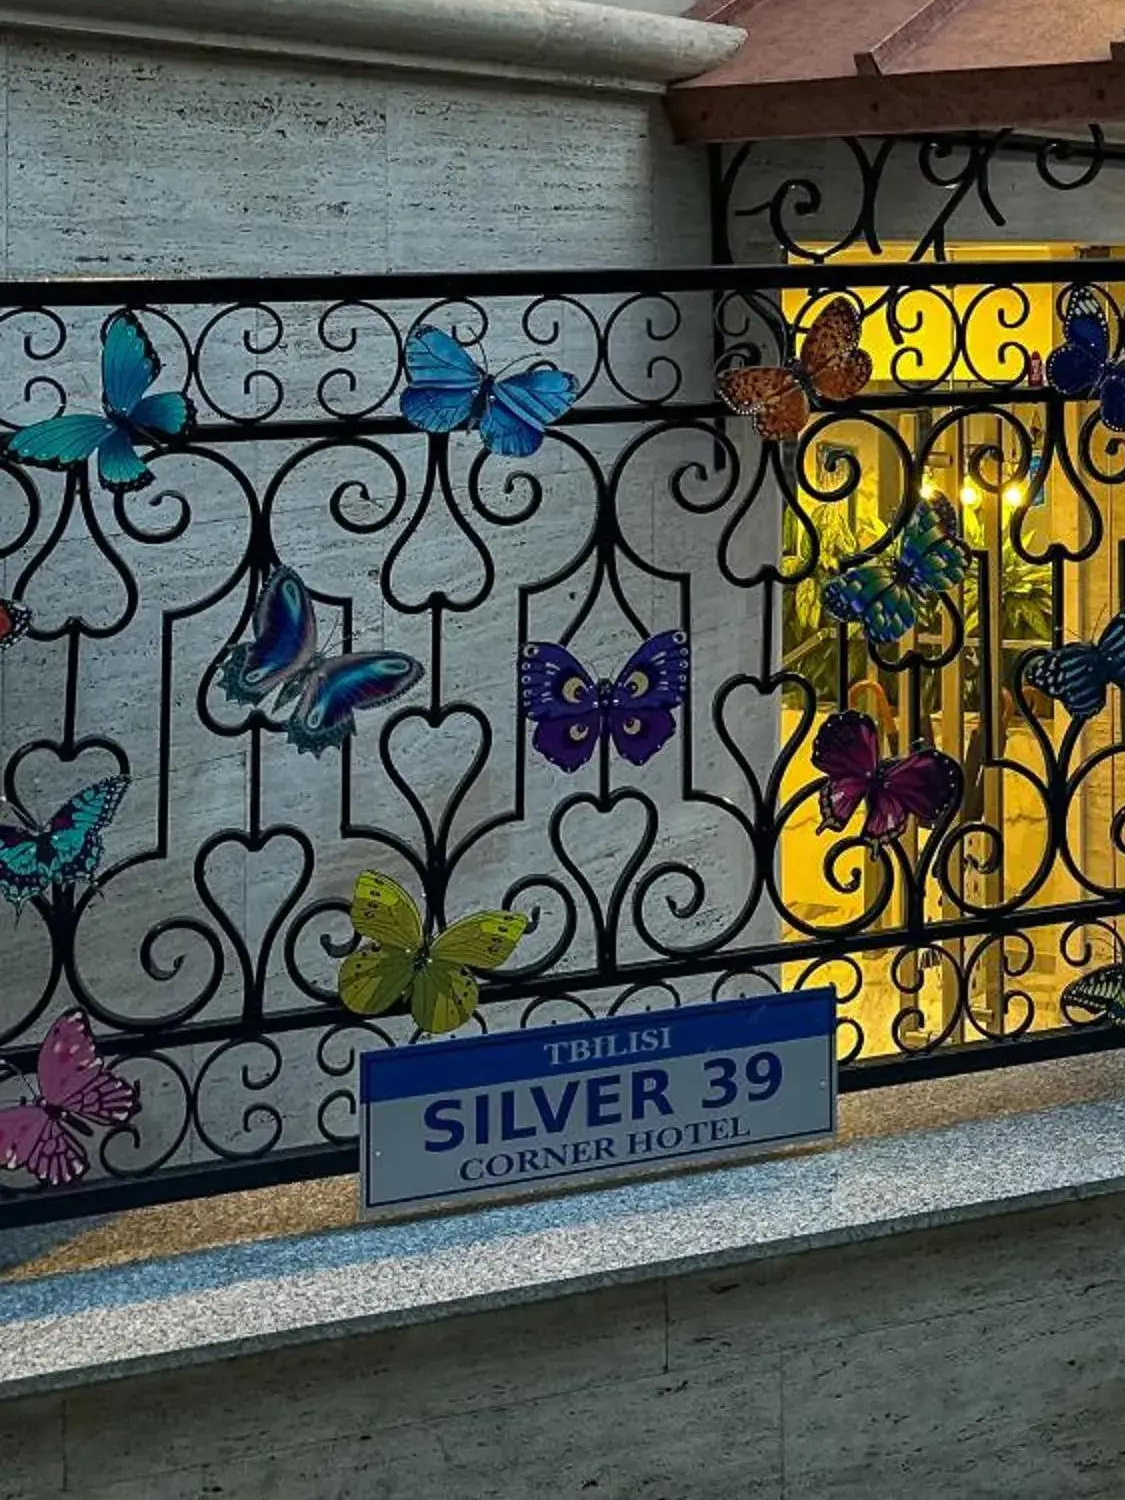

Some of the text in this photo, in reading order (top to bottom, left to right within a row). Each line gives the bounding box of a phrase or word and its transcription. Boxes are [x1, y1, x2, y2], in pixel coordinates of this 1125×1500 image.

[544, 1027, 672, 1065] TBILISI
[423, 1050, 783, 1153] SILVER 39
[459, 1116, 751, 1181] CORNER HOTEL
